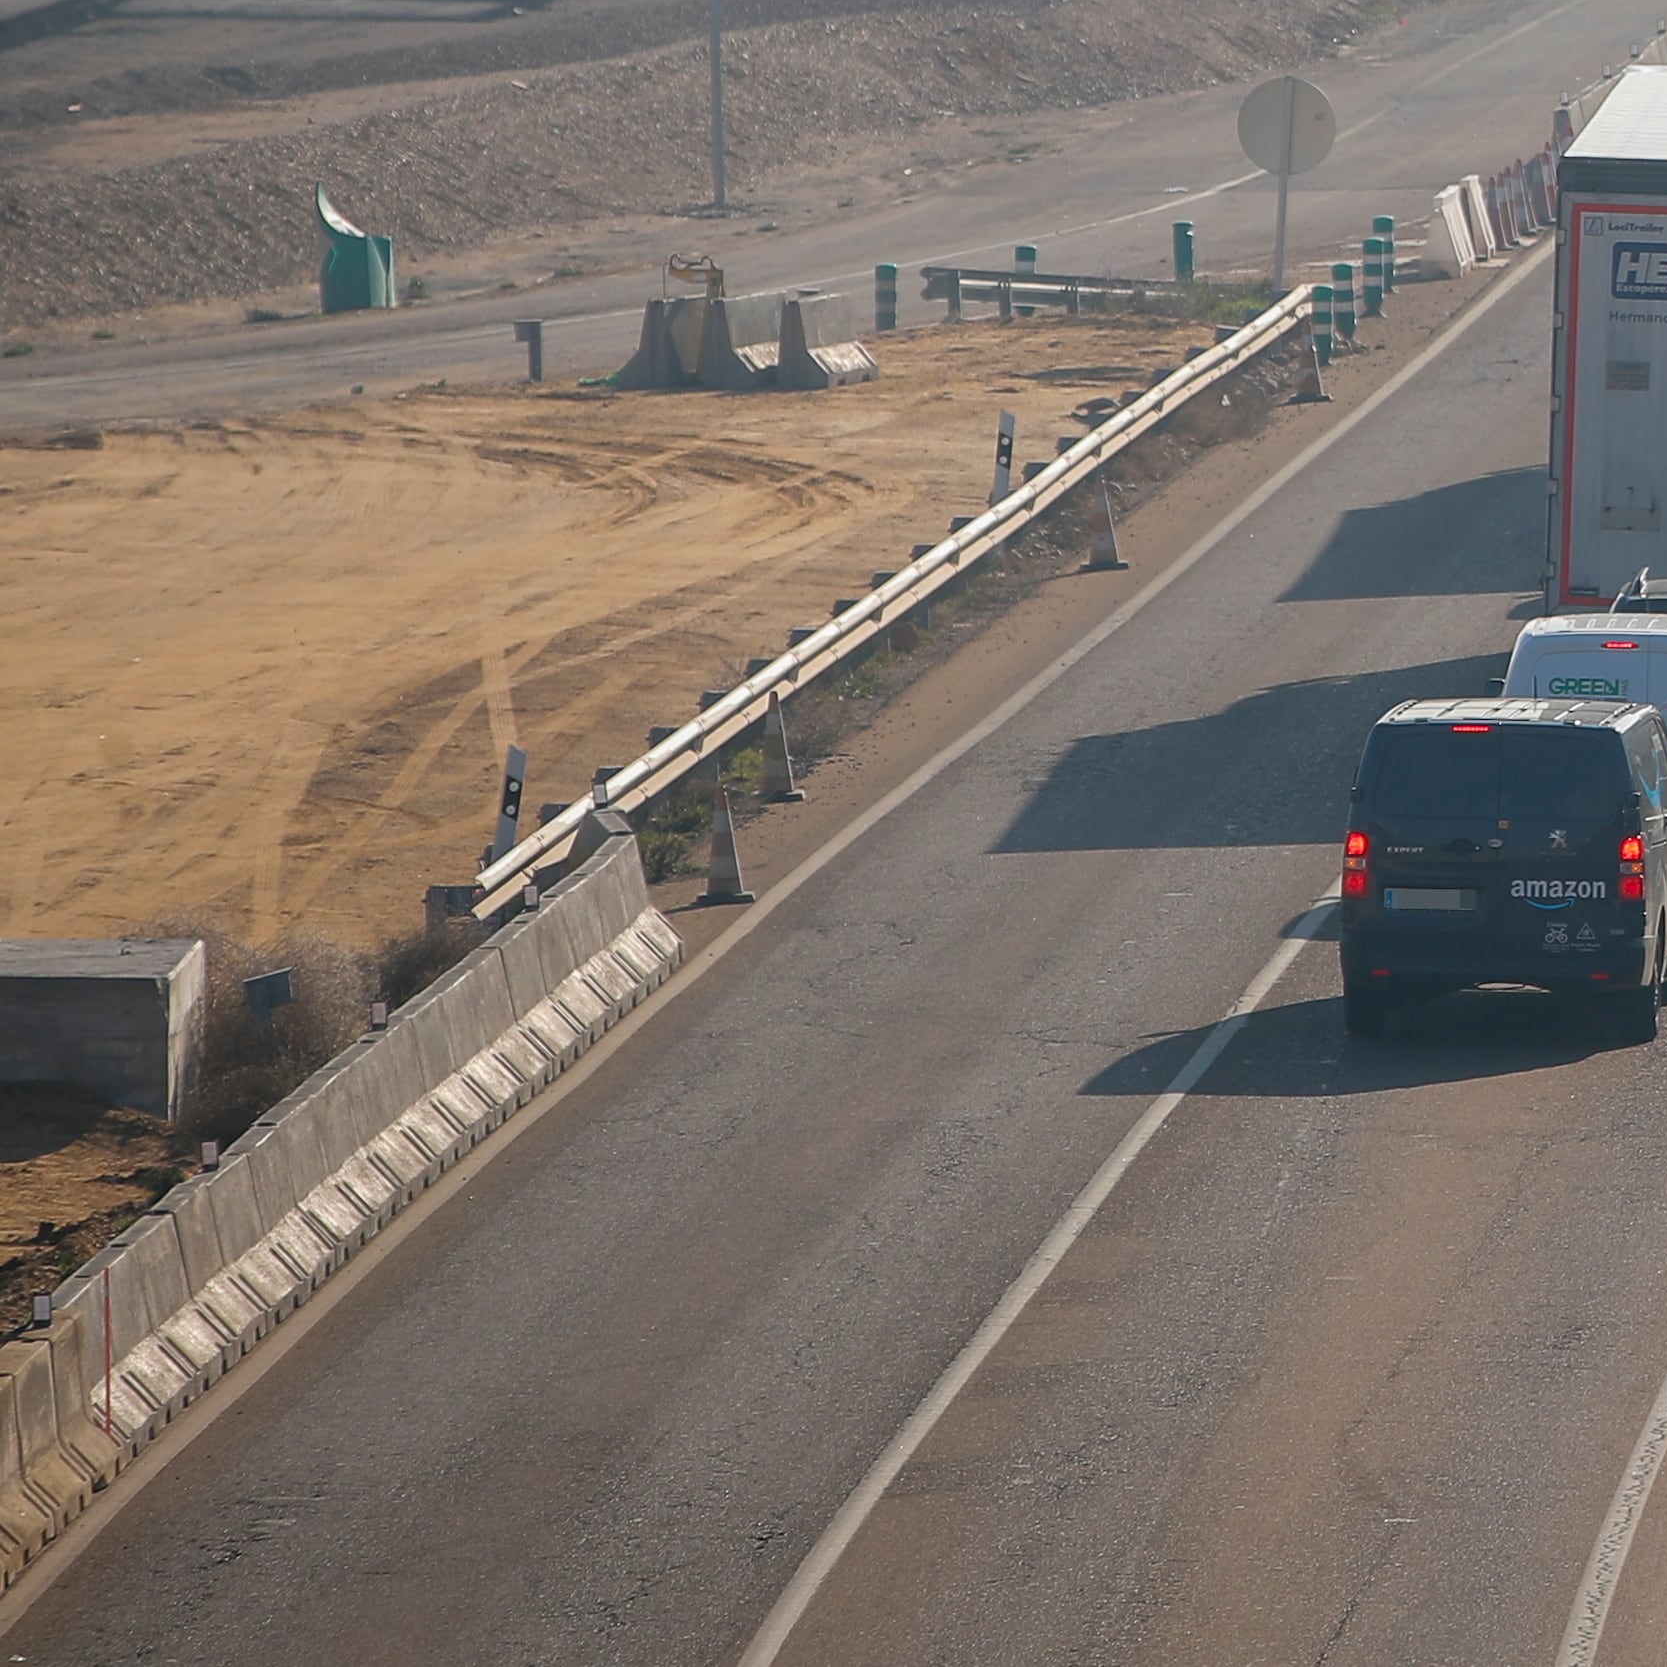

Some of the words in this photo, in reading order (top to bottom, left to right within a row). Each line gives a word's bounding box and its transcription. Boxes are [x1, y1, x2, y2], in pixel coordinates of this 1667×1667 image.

[1548, 677, 1620, 696] GREEN
[1386, 845, 1425, 854] EXPERT
[1510, 879, 1607, 899] amazon
